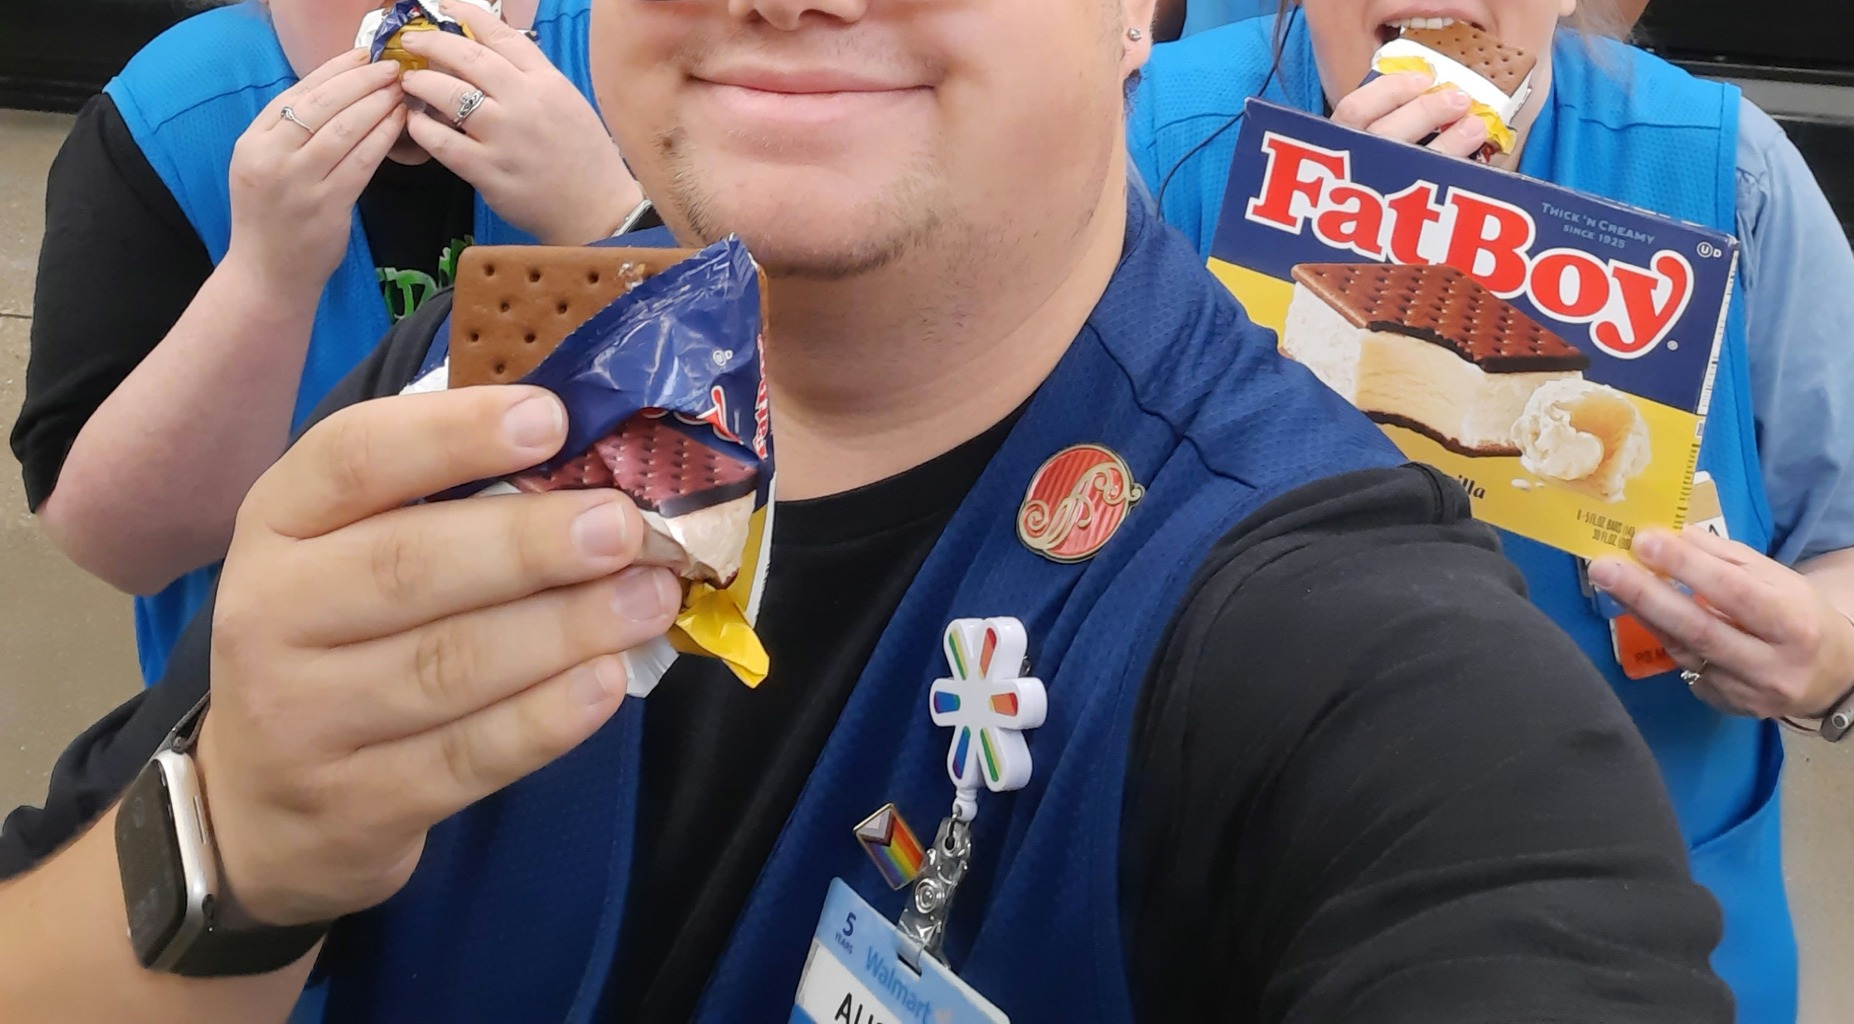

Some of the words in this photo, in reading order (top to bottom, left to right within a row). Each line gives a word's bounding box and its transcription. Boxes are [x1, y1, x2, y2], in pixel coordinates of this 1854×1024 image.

[1245, 130, 1694, 360] FatBoy
[1563, 224, 1596, 240] SINCE
[1598, 233, 1626, 249] 1925
[842, 912, 857, 936] 5
[864, 944, 931, 1024] Walmart
